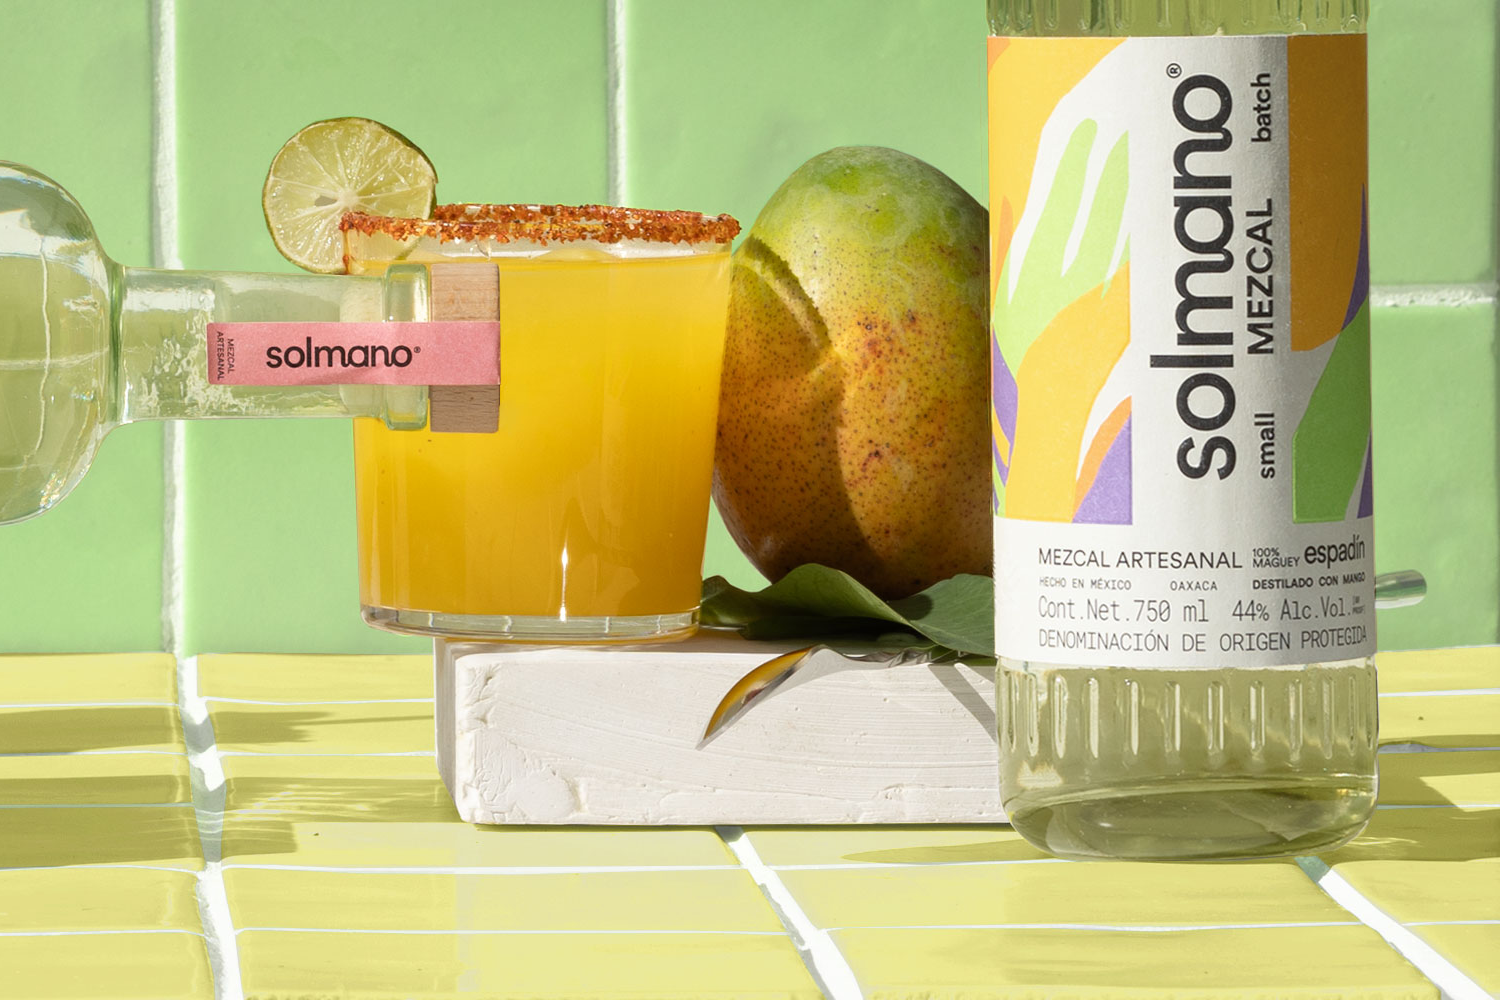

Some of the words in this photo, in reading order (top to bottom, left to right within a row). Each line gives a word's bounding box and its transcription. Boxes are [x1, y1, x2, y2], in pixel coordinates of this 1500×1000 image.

[1250, 72, 1271, 142] batch
[1246, 198, 1274, 355] MEZCAL
[1254, 412, 1275, 479] small
[1039, 548, 1110, 568] MEZCAL
[1115, 550, 1242, 569] ARTESANAL
[1253, 548, 1279, 557] 100%
[1253, 557, 1300, 568] MAGUEY
[1304, 534, 1365, 569] espadín
[1039, 577, 1067, 588] HECHO
[1072, 579, 1085, 589] EN
[1090, 577, 1131, 590] MÉXICO
[1170, 580, 1217, 590] OAXACA
[1252, 576, 1313, 590] DESTILADO
[1319, 575, 1339, 586] CON
[1342, 572, 1366, 585] MANGO
[1183, 599, 1209, 623] ml
[1232, 599, 1269, 621] 44%
[1039, 629, 1169, 652] DENOMINACIÓN
[1182, 633, 1206, 652] DE
[1220, 632, 1291, 651] ORIGEN
[1301, 625, 1367, 648] PROTEGIDA
